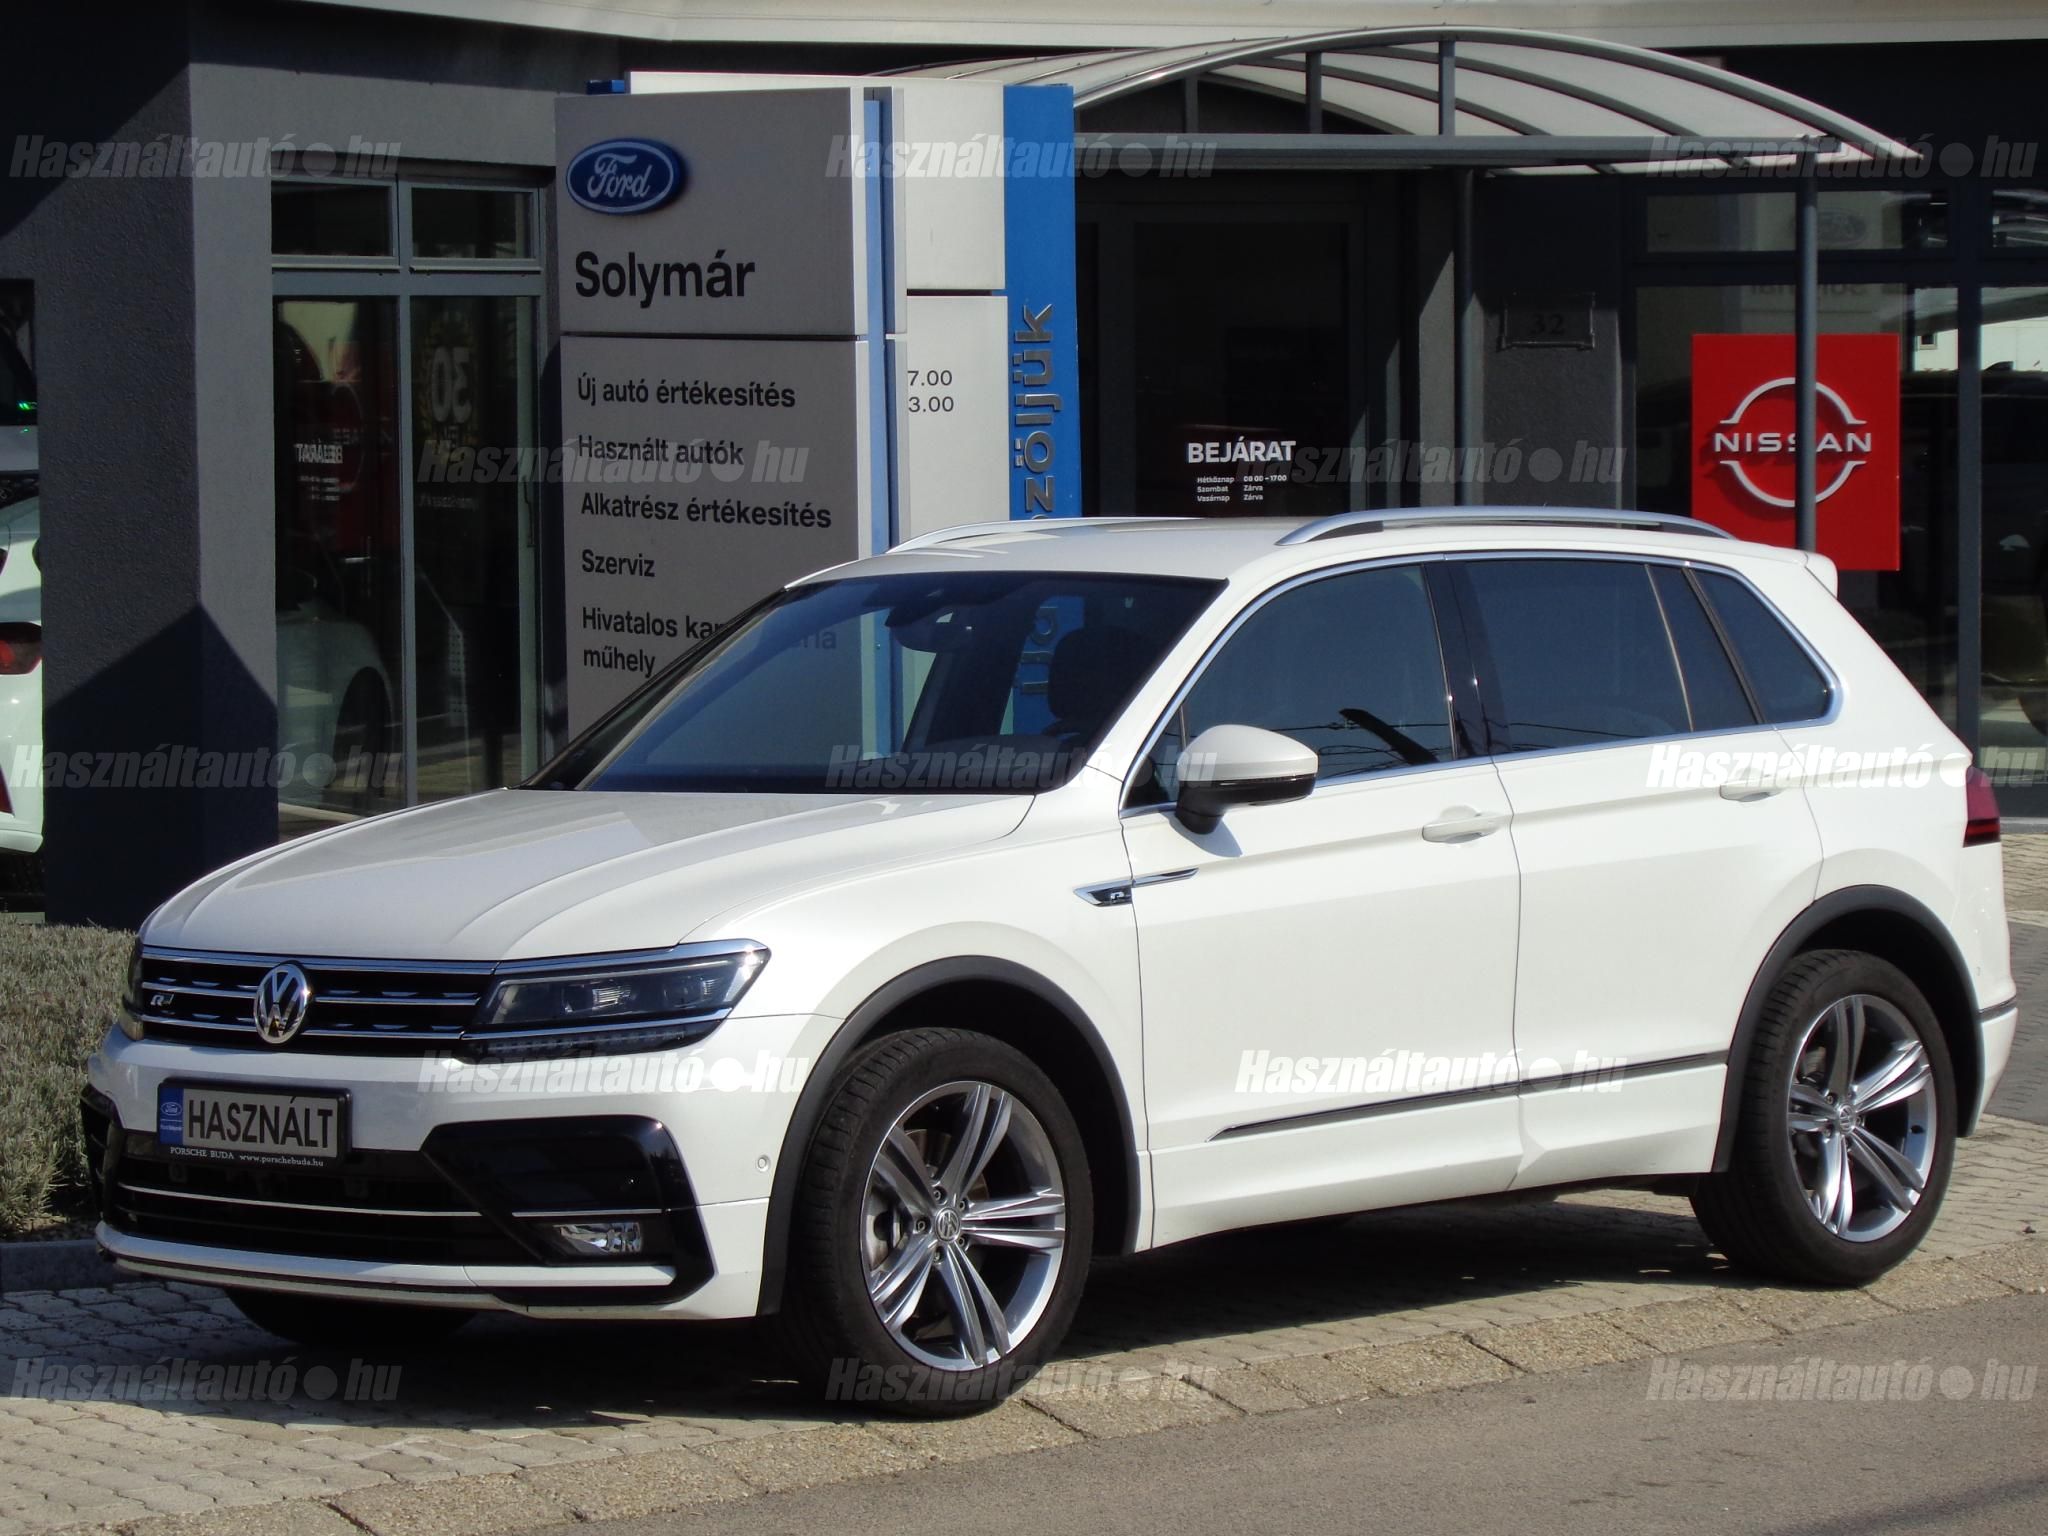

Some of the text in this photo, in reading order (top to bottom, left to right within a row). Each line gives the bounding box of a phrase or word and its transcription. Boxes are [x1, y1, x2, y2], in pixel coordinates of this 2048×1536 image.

[587, 153, 653, 200] Ford
[575, 249, 755, 309] Solymár
[1530, 313, 1565, 335] 32
[577, 372, 796, 408] Új autó értékesítés
[1013, 303, 1062, 521] zöljük
[578, 434, 744, 465] Használt autók
[1187, 436, 1297, 464] BEJÁRAT
[1197, 476, 1235, 485] Hétköznap
[1197, 484, 1264, 493] Szombat Zárva
[581, 492, 832, 528] Alkatrész értékesítés
[1197, 493, 1264, 503] Vasárnap Zárva
[581, 549, 656, 578] Szerviz
[582, 606, 677, 638] Hivatalos
[583, 646, 656, 679] műhely
[188, 1096, 333, 1149] HASZNÁLT
[170, 1146, 324, 1167] PORSCHE BUDA www.porschebuda.hu
